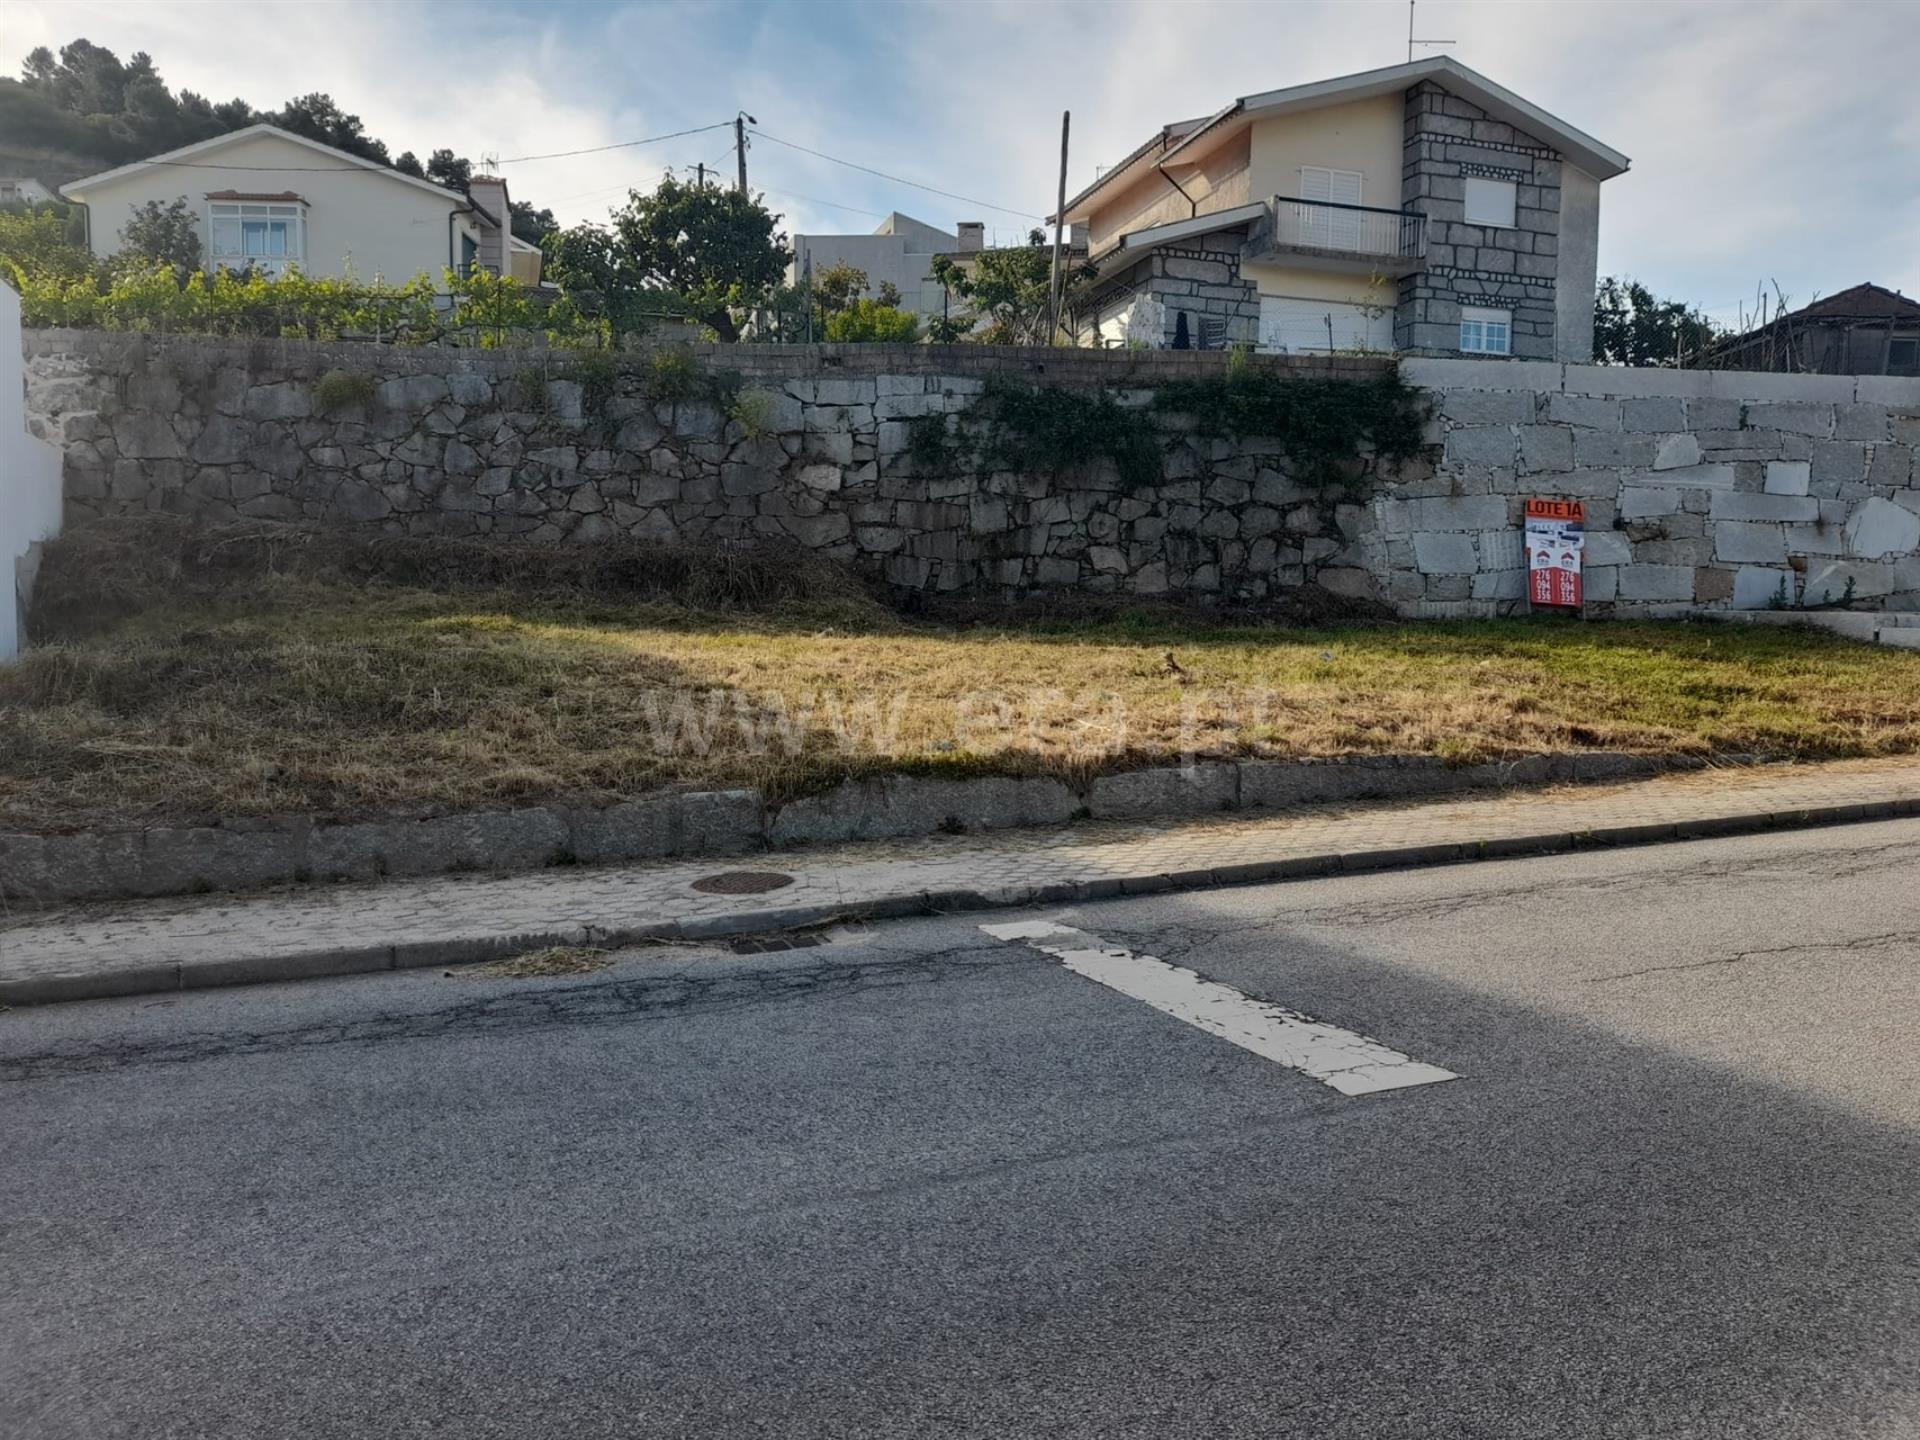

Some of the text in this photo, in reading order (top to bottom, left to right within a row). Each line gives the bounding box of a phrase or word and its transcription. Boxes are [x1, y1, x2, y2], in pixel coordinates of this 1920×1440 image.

[1527, 501, 1582, 516] LOTE 1A
[1536, 570, 1551, 580] 276
[1561, 572, 1575, 582] 276
[1536, 580, 1551, 590] 094
[1560, 582, 1575, 592] 094
[1537, 590, 1551, 601] 356
[1560, 592, 1575, 602] 356
